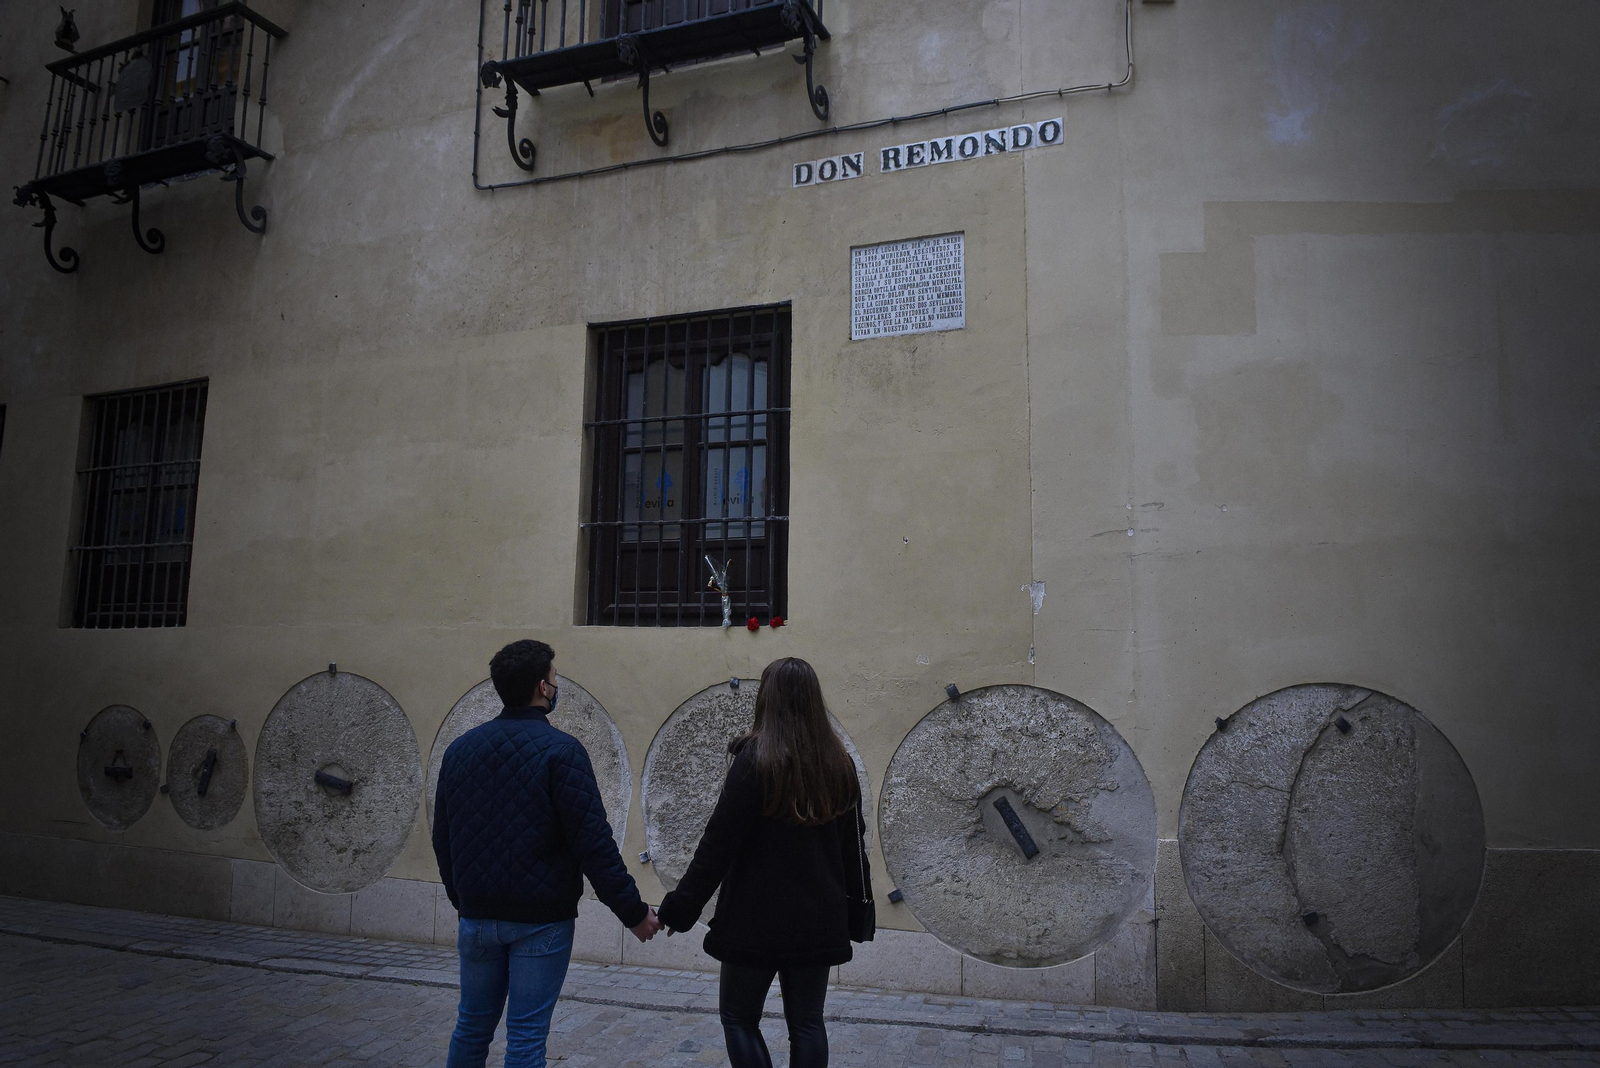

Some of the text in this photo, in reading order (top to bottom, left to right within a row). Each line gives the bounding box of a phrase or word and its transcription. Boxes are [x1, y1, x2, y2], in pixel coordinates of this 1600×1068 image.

[795, 119, 1061, 185] DON REMONDO
[895, 276, 915, 284] ESPOSA
[855, 313, 891, 322] EJEMPLARES
